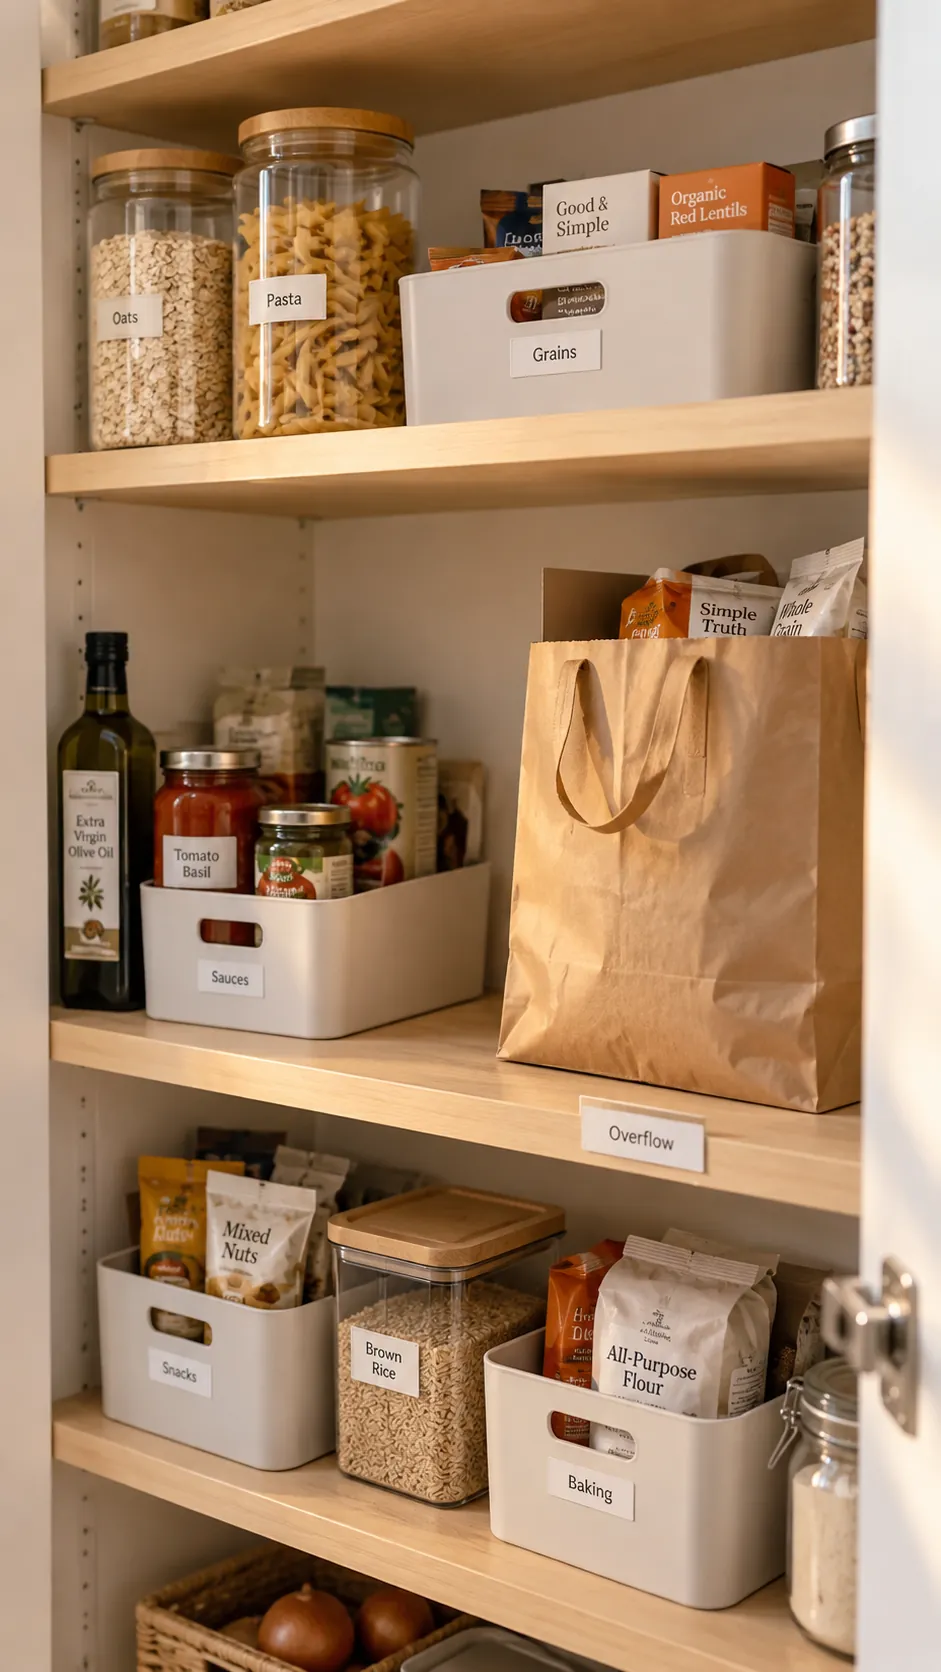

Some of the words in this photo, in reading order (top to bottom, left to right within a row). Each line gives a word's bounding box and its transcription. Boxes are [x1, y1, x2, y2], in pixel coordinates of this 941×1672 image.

[556, 197, 595, 216] Good
[598, 196, 608, 211] &
[671, 185, 727, 208] Organic
[670, 210, 697, 226] Red
[700, 202, 748, 222] Lentils
[556, 216, 609, 238] Simple
[266, 293, 302, 308] Pasta
[112, 311, 138, 326] Oats
[532, 345, 577, 362] Grains
[700, 602, 757, 622] Simple
[779, 598, 813, 620] Whole
[702, 618, 747, 636] Truth
[773, 620, 803, 636] Grain
[76, 814, 105, 828] Extra
[73, 830, 106, 845] Virgin
[68, 845, 96, 858] Olive
[98, 846, 114, 859] Oil
[173, 848, 220, 863] Tomato
[182, 865, 211, 879] Basil
[211, 970, 249, 987] Sauces
[609, 1125, 674, 1151] Overflow
[222, 1220, 272, 1245] Mixed
[221, 1242, 258, 1264] Nuts
[365, 1341, 402, 1364] Brown
[606, 1344, 698, 1381] All-Purpose
[162, 1361, 197, 1384] Snacks
[372, 1362, 396, 1380] Rice
[622, 1370, 664, 1397] Flour
[568, 1474, 613, 1504] Baking
